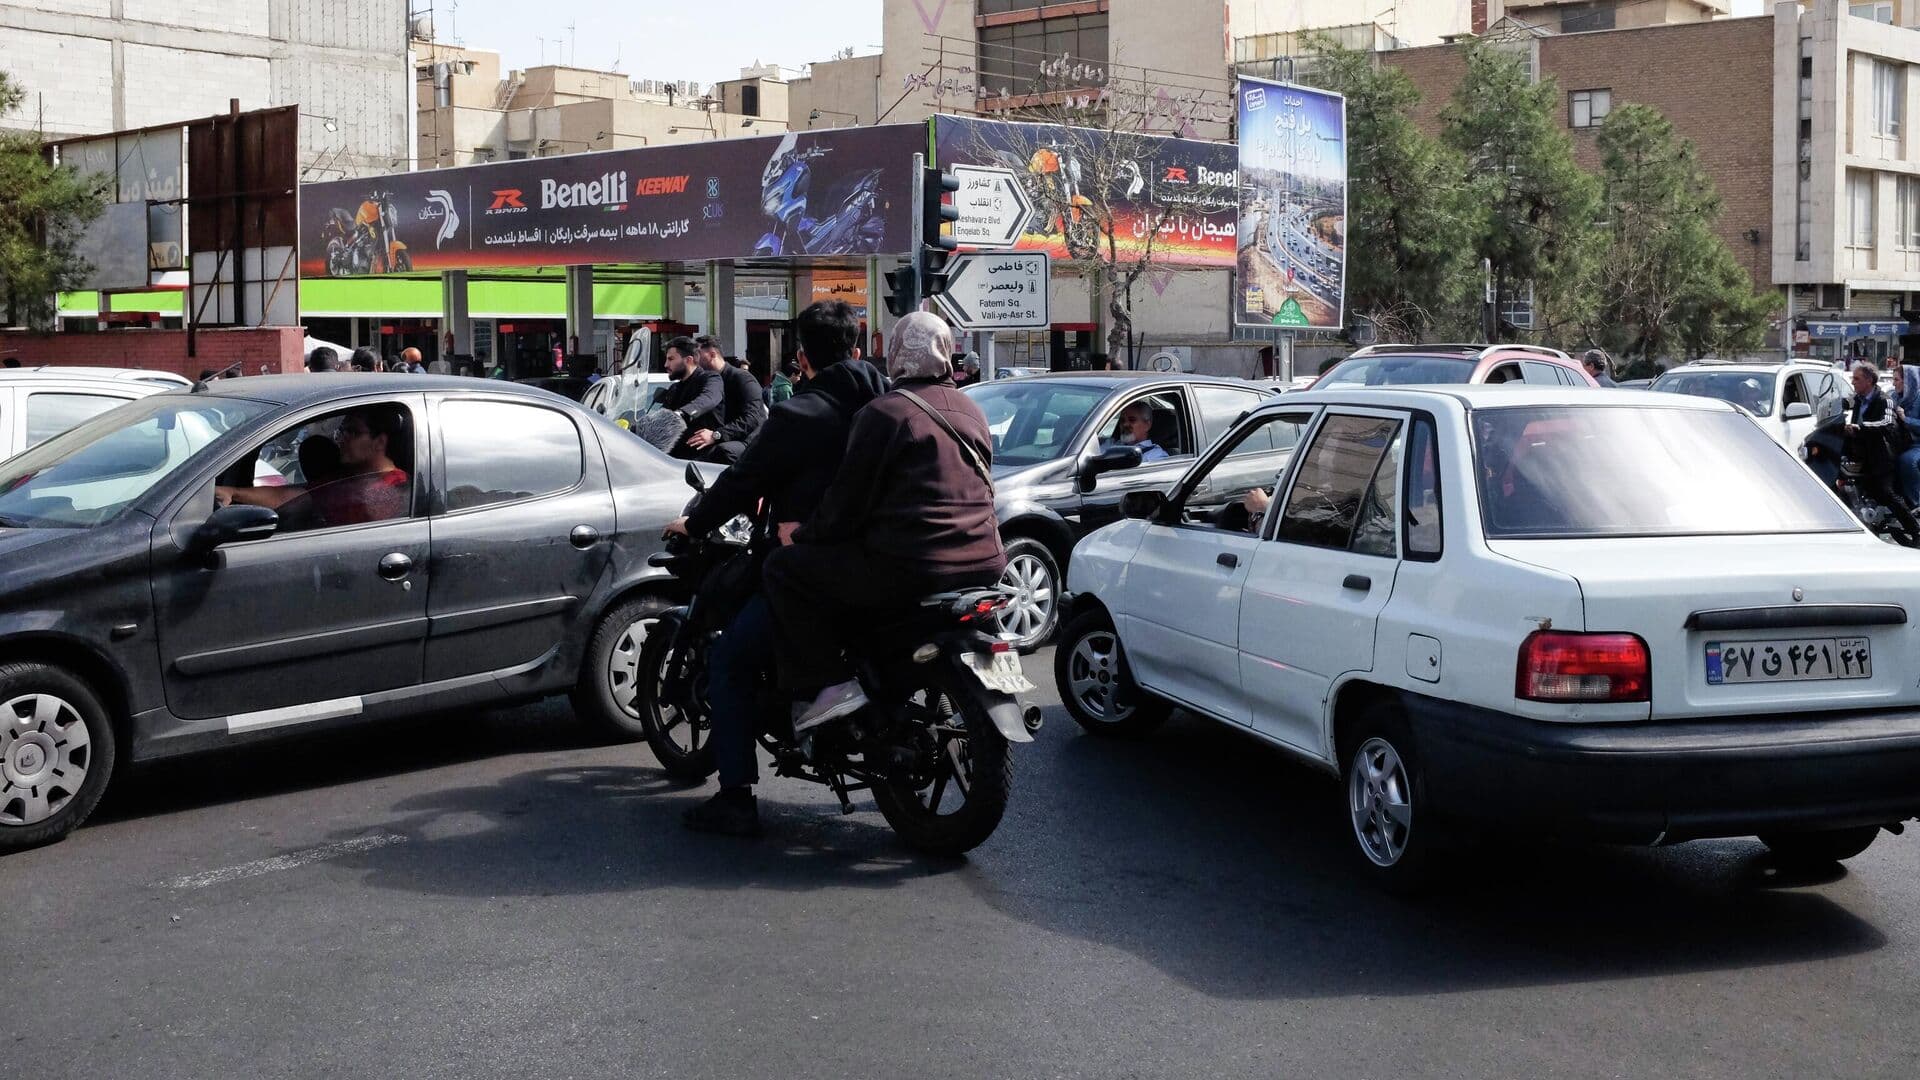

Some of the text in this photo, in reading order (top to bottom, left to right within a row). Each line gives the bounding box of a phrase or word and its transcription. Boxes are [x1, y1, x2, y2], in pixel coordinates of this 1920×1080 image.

[1274, 108, 1312, 140] پل فتح
[541, 170, 690, 209] Benelli KEEWAY
[967, 177, 991, 189] کشاورز
[969, 197, 992, 209] انقلاب
[484, 218, 690, 246] گارانتی ۱۸ ماهه بیمه سرقت رایگان اقساط بلندمدت
[1179, 216, 1189, 240] با
[1192, 217, 1236, 241] هیجان
[988, 261, 1023, 274] فاطمی
[988, 281, 1024, 294] ولیعصر
[979, 299, 1006, 308] Fatemi
[981, 310, 1038, 321] Vali-ye-Asr St.
[1723, 644, 1868, 678] ۶۷ ق ۴۶۱ ۴۴
